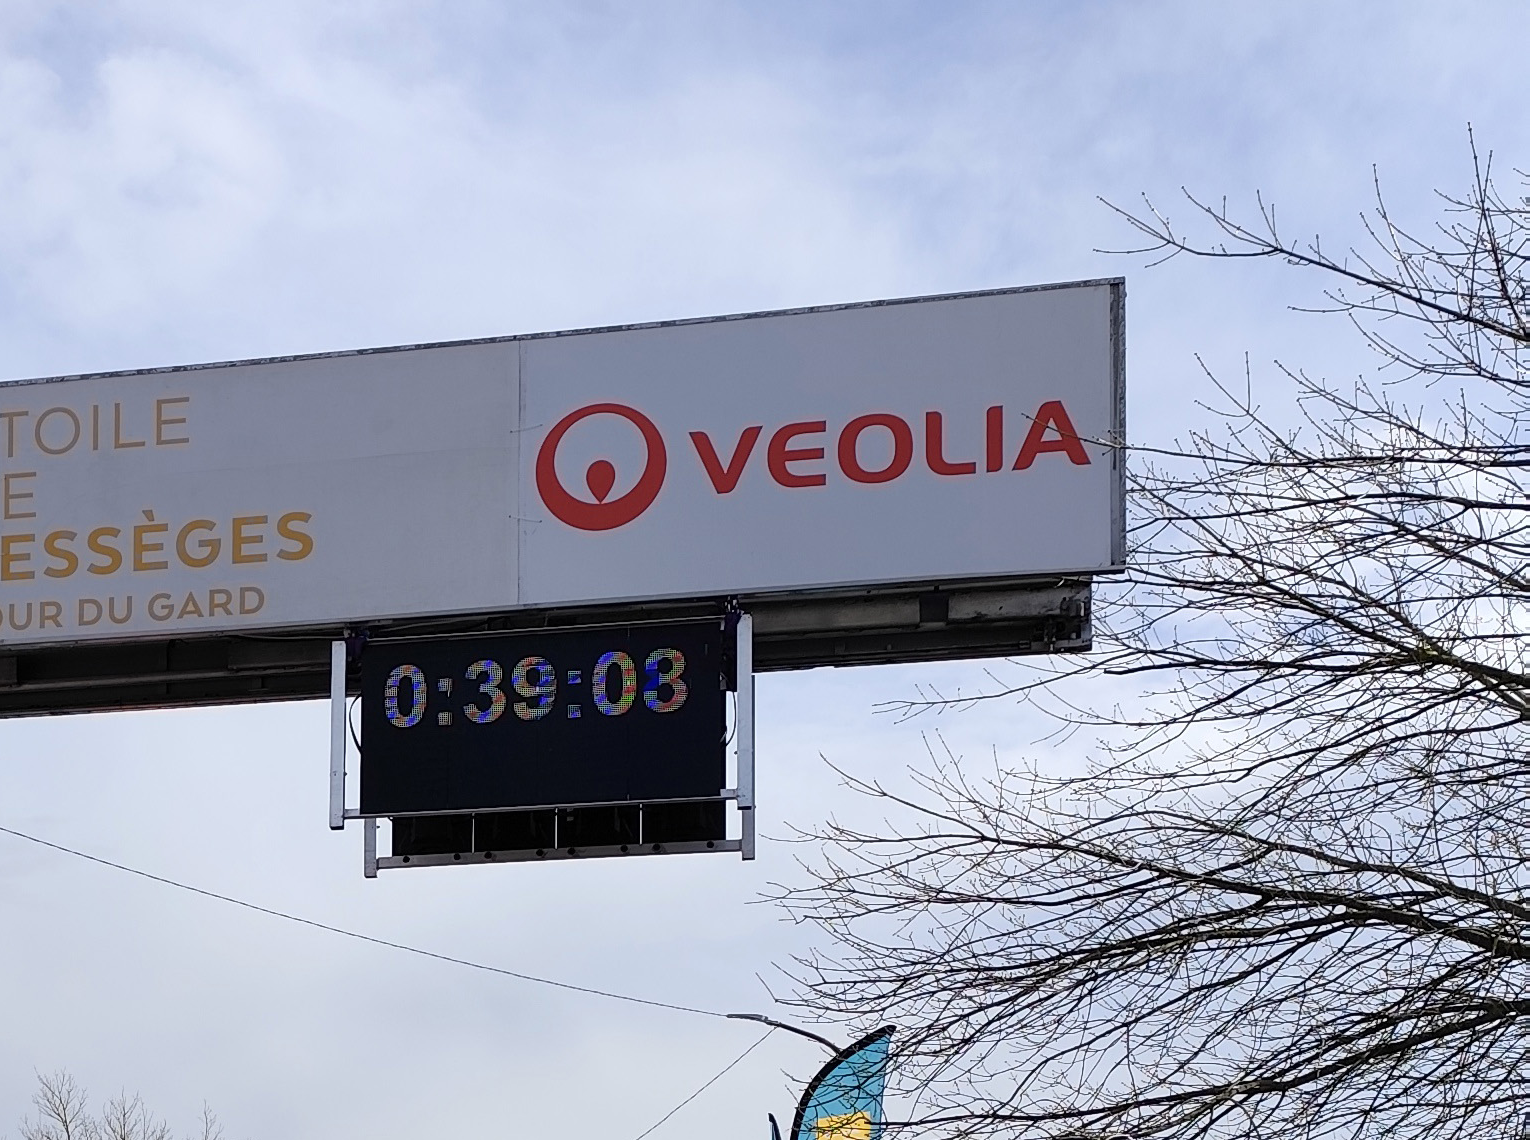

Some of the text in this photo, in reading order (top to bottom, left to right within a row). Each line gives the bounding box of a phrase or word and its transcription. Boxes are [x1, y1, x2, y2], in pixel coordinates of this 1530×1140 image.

[688, 399, 1092, 495] VEOLIA
[77, 597, 133, 627] DU
[148, 586, 266, 621] GARD
